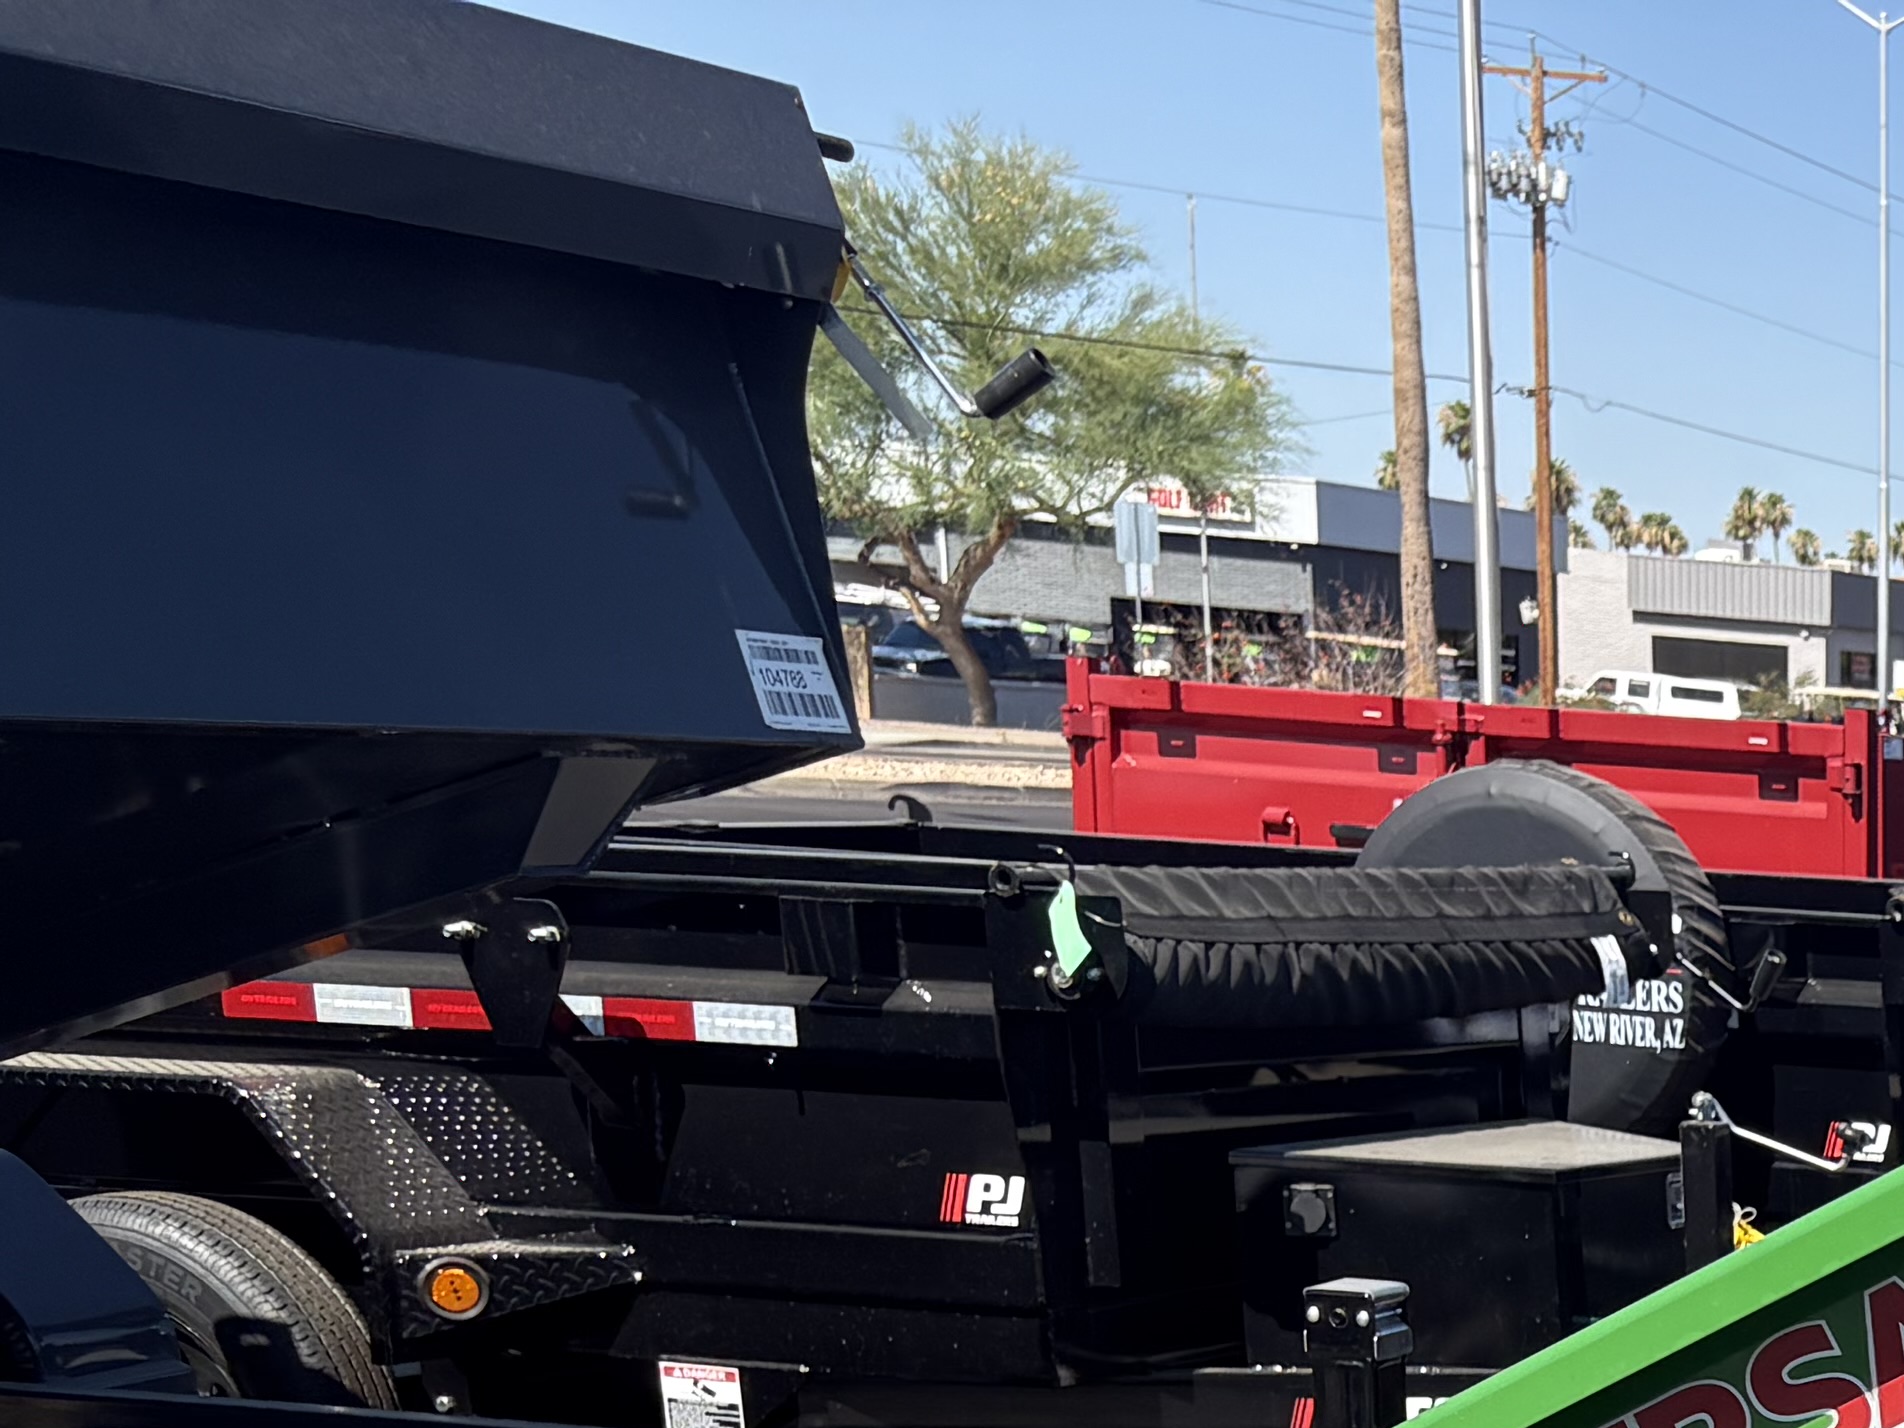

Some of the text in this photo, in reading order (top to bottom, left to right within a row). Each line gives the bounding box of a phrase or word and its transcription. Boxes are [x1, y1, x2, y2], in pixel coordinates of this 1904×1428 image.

[1572, 1009, 1686, 1054] NEW RIVER, AZ
[965, 1173, 1025, 1215] PJ
